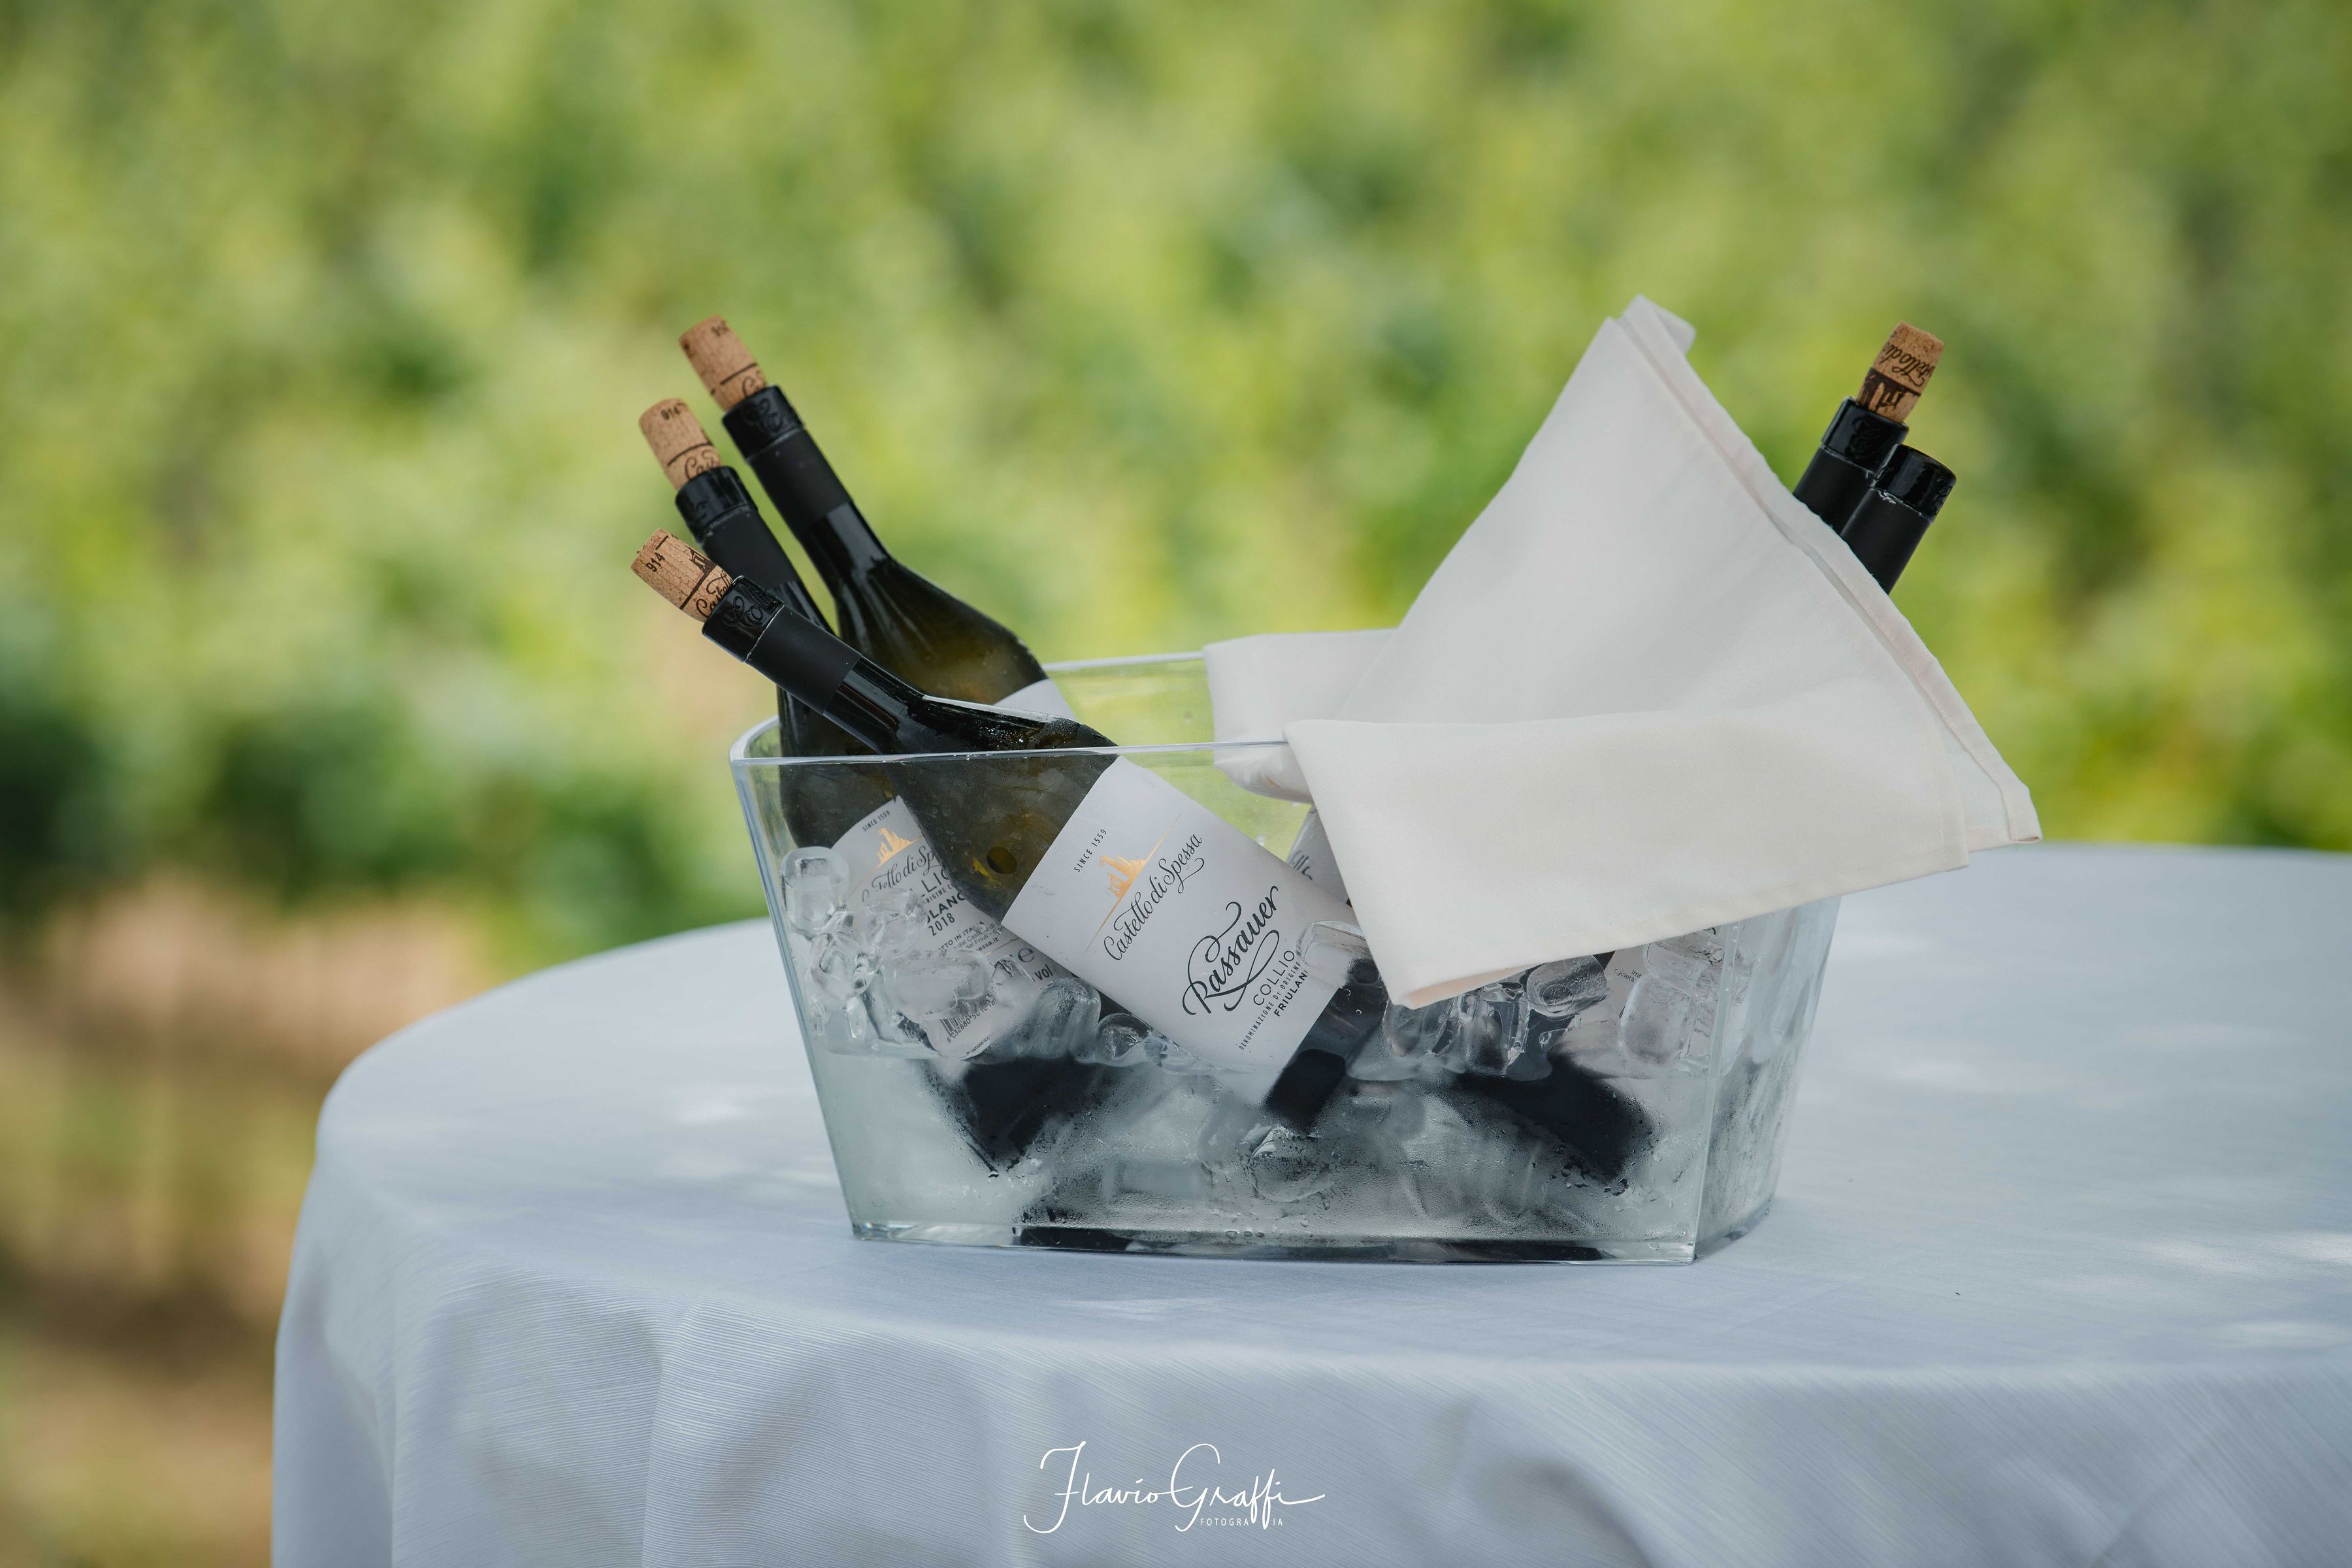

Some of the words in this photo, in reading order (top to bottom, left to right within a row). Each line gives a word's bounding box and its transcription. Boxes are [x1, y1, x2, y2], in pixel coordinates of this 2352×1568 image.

[645, 552, 665, 572] 914
[862, 819, 877, 832] SINCE
[879, 810, 890, 821] 1559
[1073, 849, 1093, 873] SINCE
[1091, 828, 1107, 847] 1559
[1158, 834, 1205, 894] Spessa
[903, 855, 917, 877] di
[925, 887, 947, 904] RIGINE
[1151, 875, 1168, 904] di
[928, 913, 955, 936] 2018
[954, 934, 962, 942] IN
[1104, 892, 1153, 960] Castello
[1183, 885, 1280, 1015] Rassauer
[1034, 964, 1053, 981] vol
[1253, 950, 1295, 1005] COLLIO
[1273, 970, 1308, 1017] FRIULAN
[1239, 1002, 1275, 1051] DENOMINAZIONE
[1273, 991, 1281, 1000] DI
